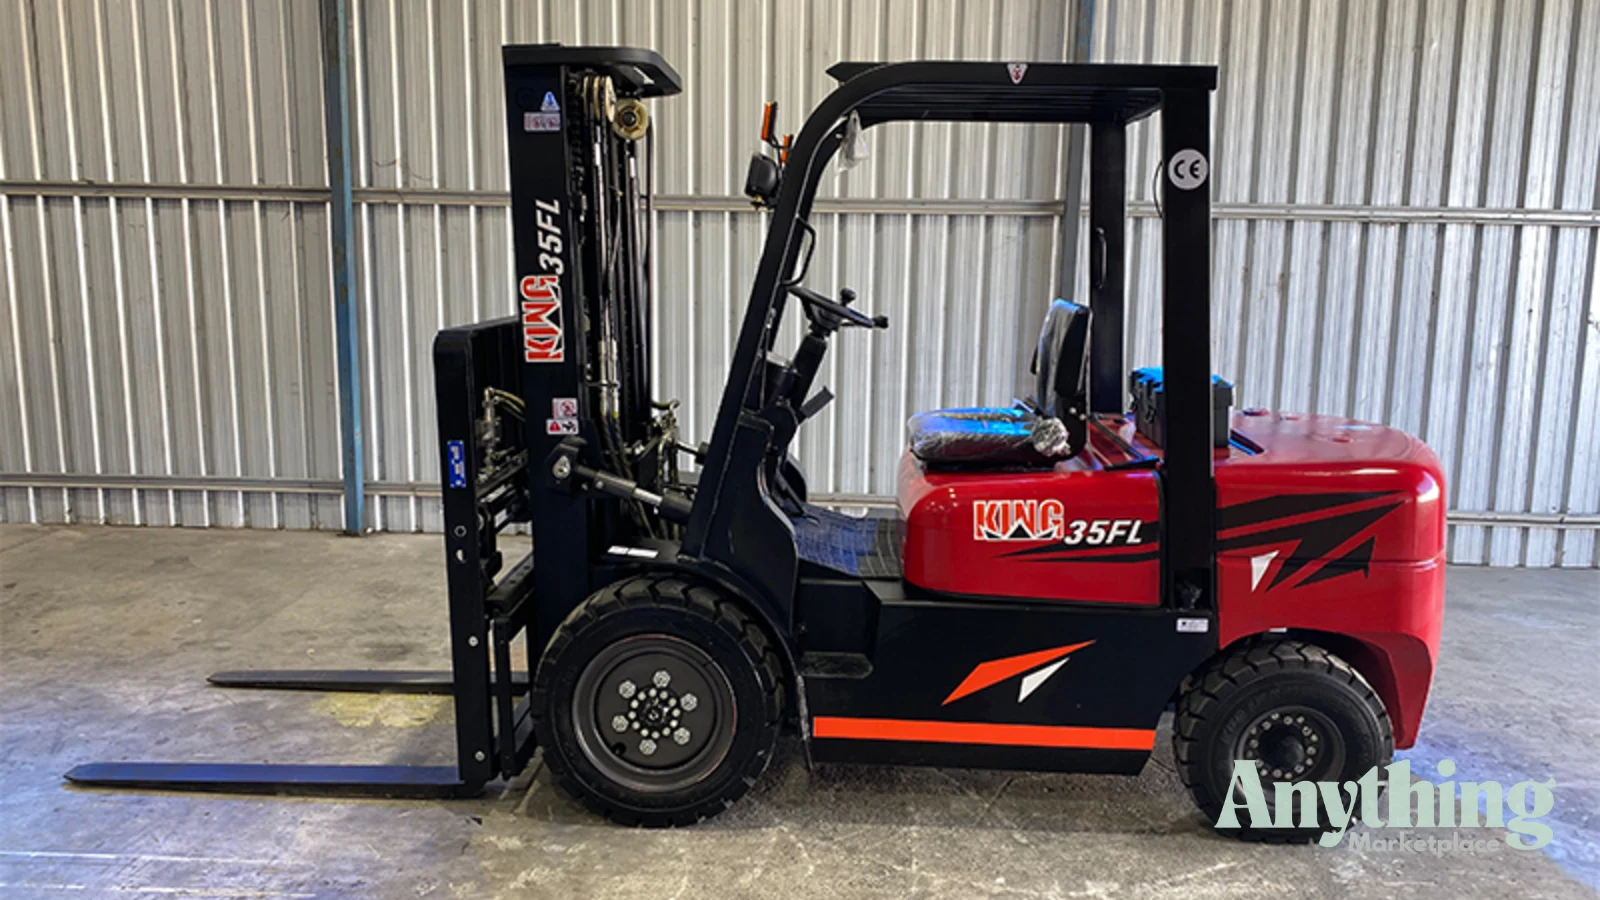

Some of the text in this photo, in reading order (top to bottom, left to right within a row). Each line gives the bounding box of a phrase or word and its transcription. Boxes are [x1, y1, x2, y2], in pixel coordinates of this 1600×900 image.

[1174, 160, 1200, 179] CE
[521, 199, 564, 362] KING 35FL
[973, 499, 1143, 545] KING 35FL
